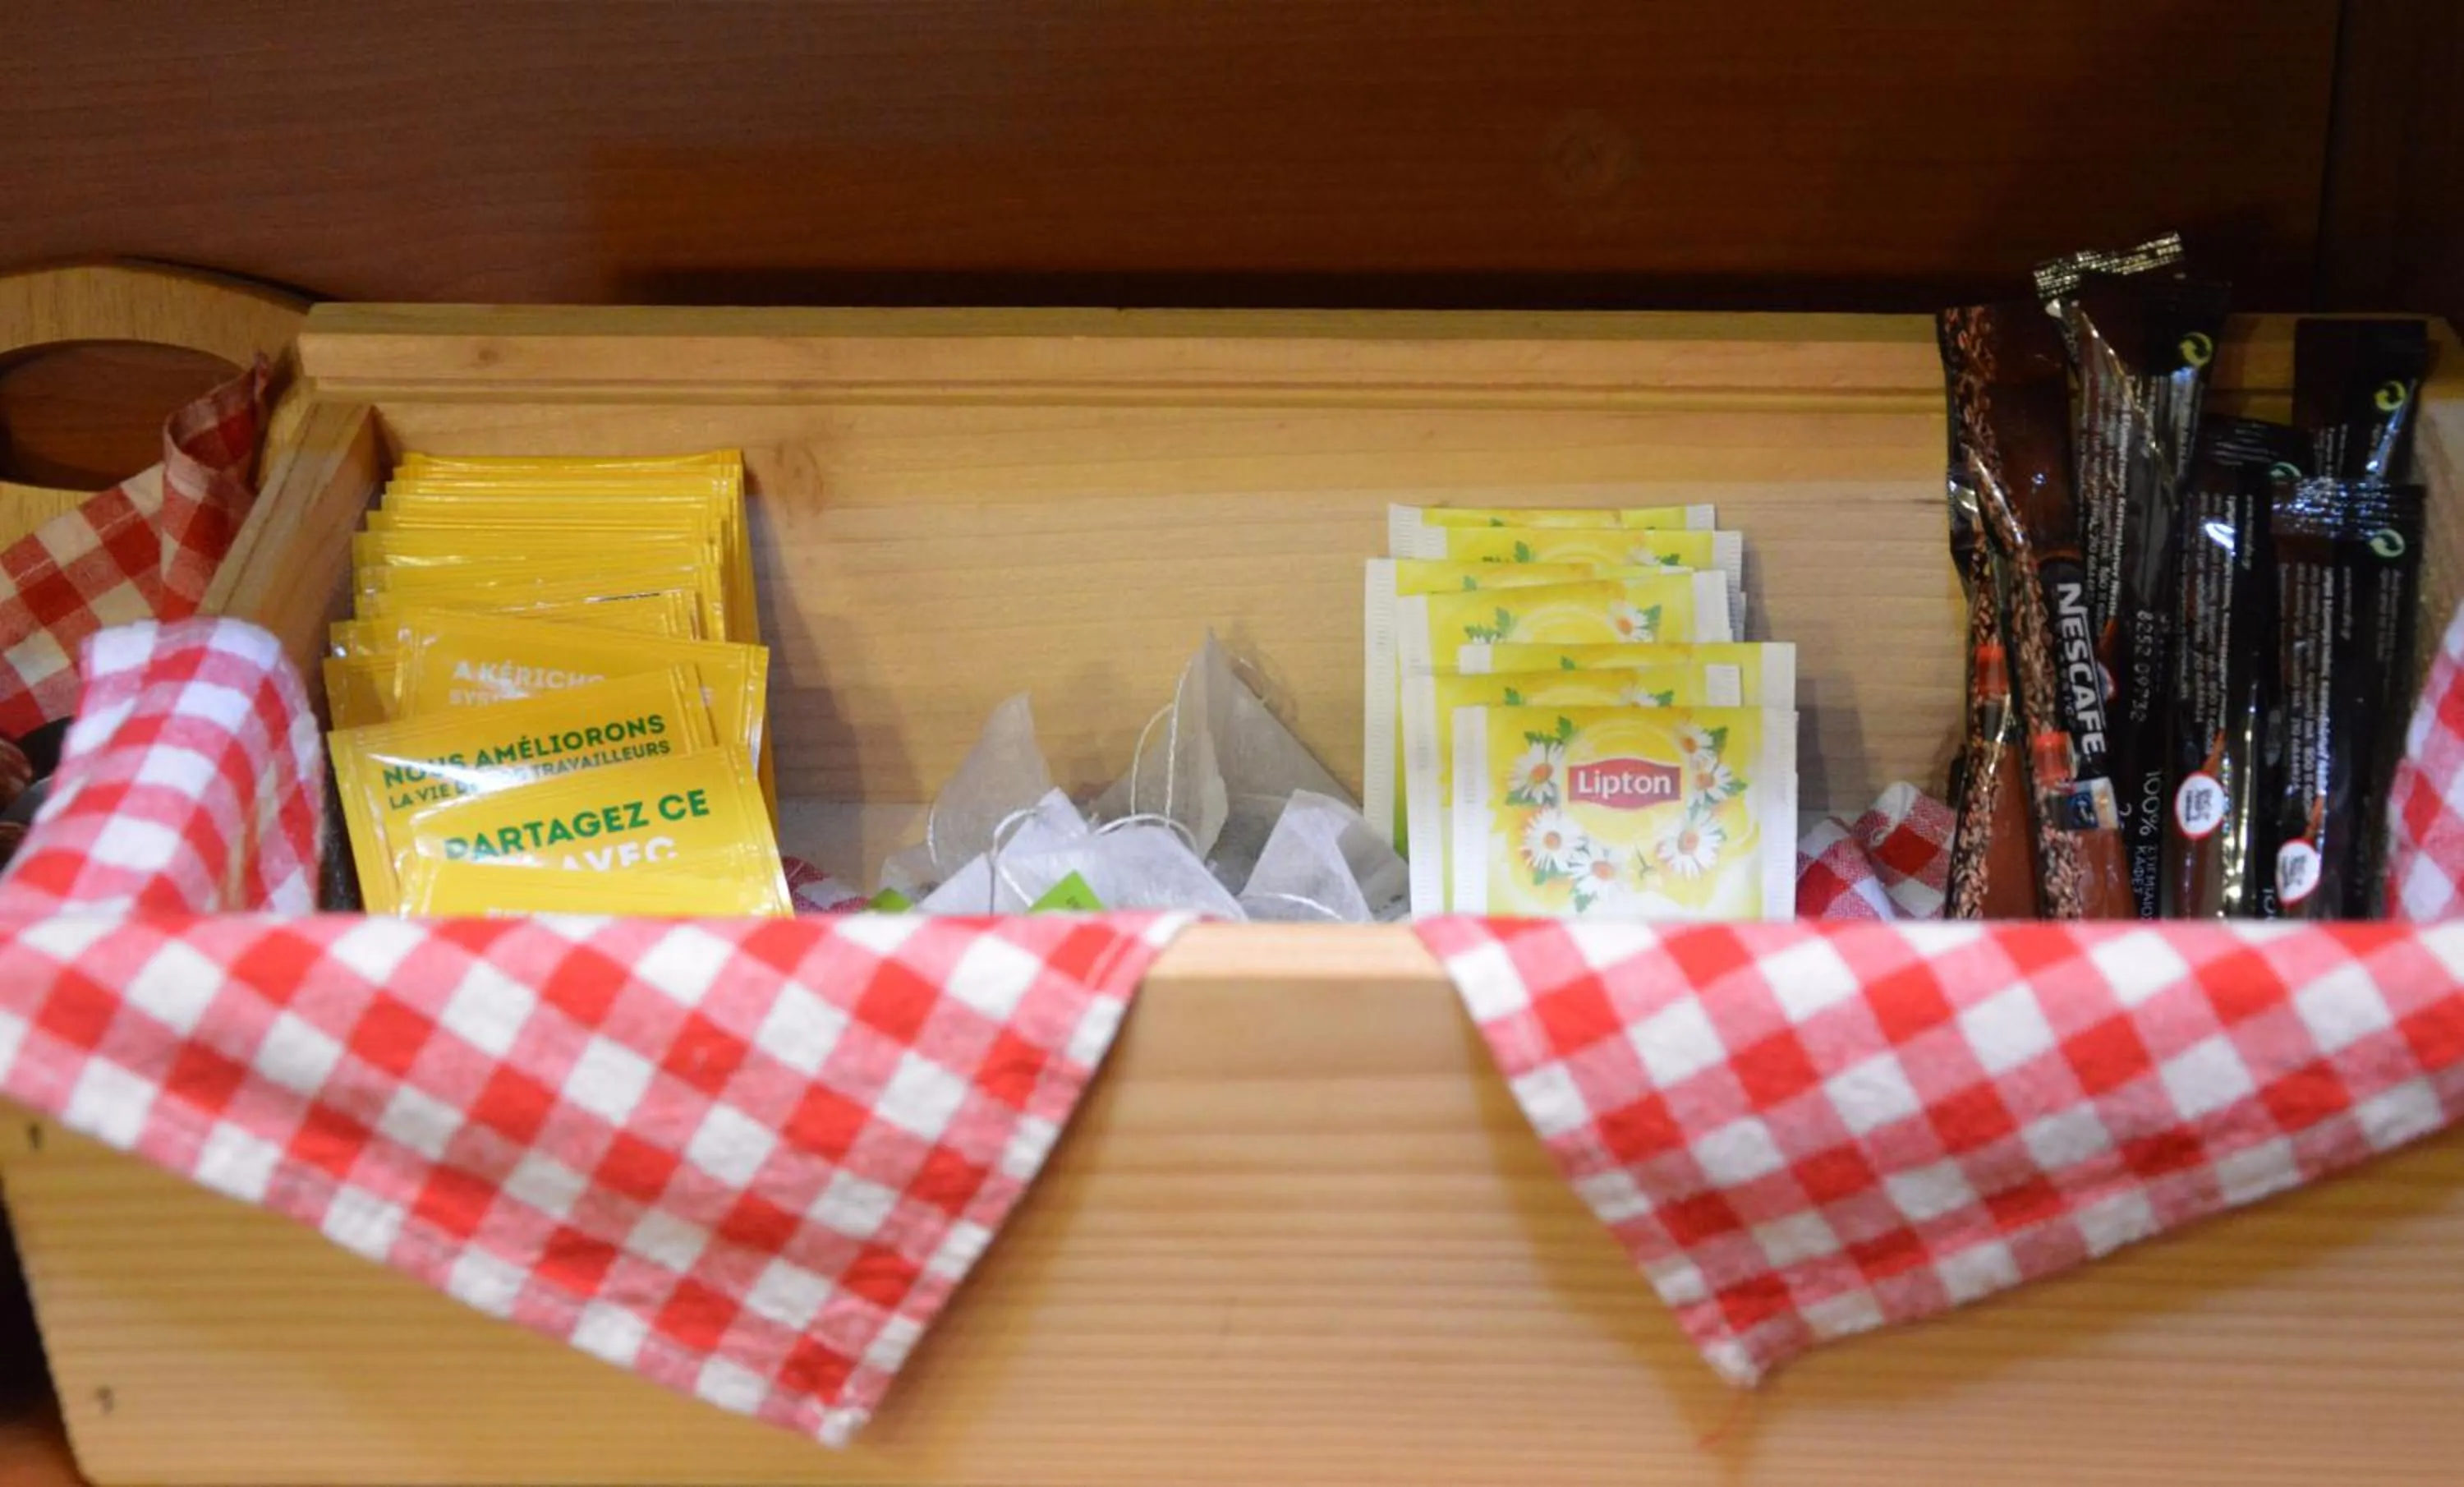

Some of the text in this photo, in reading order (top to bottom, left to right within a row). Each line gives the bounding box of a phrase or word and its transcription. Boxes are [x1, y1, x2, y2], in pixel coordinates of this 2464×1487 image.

[479, 660, 605, 691] KÉRICH
[475, 714, 666, 770] AMÉLIORONS
[389, 793, 414, 811] LA
[416, 783, 451, 802] VIE
[531, 739, 671, 779] TRAVAILLEURS
[1577, 771, 1671, 799] Lipton
[2139, 770, 2163, 836] 100%
[444, 789, 710, 860] PARTAGEZ CE
